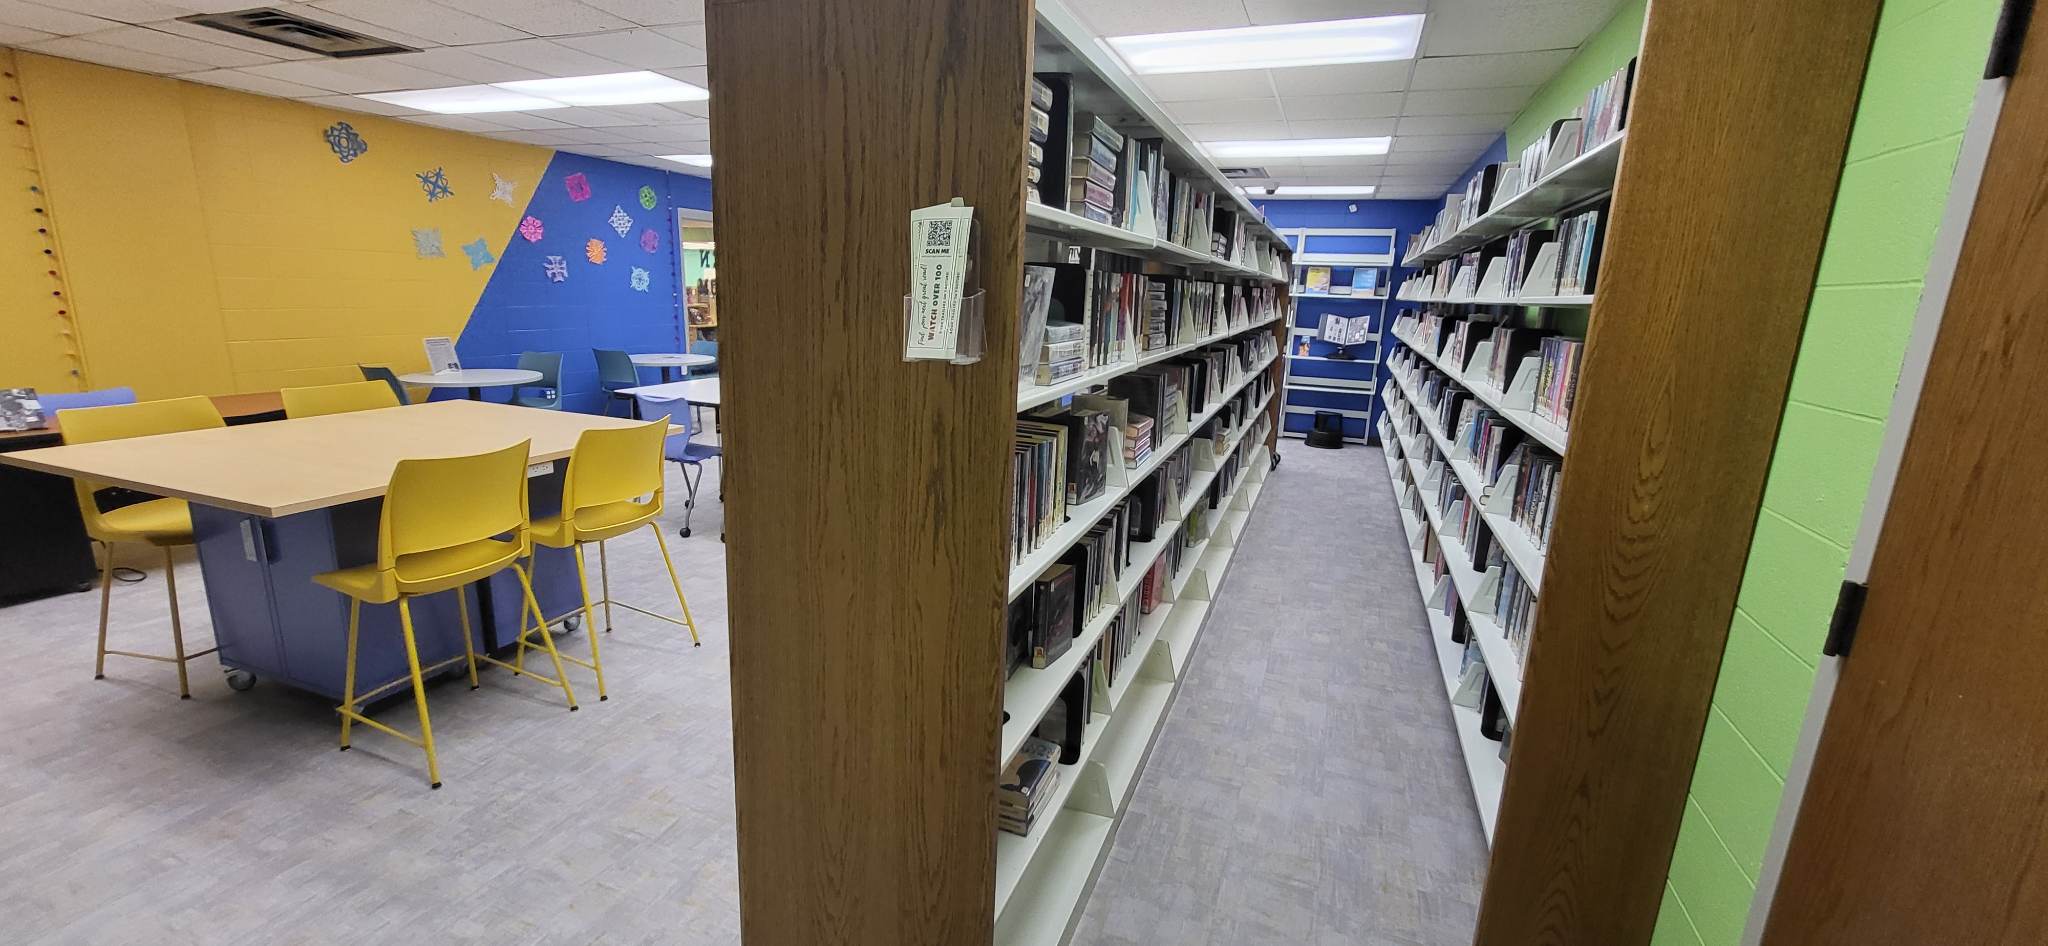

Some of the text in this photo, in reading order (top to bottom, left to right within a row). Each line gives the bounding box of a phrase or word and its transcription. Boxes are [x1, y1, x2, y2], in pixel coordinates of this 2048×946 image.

[919, 283, 929, 300] great
[932, 283, 940, 306] OVER
[928, 308, 938, 341] WATCH
